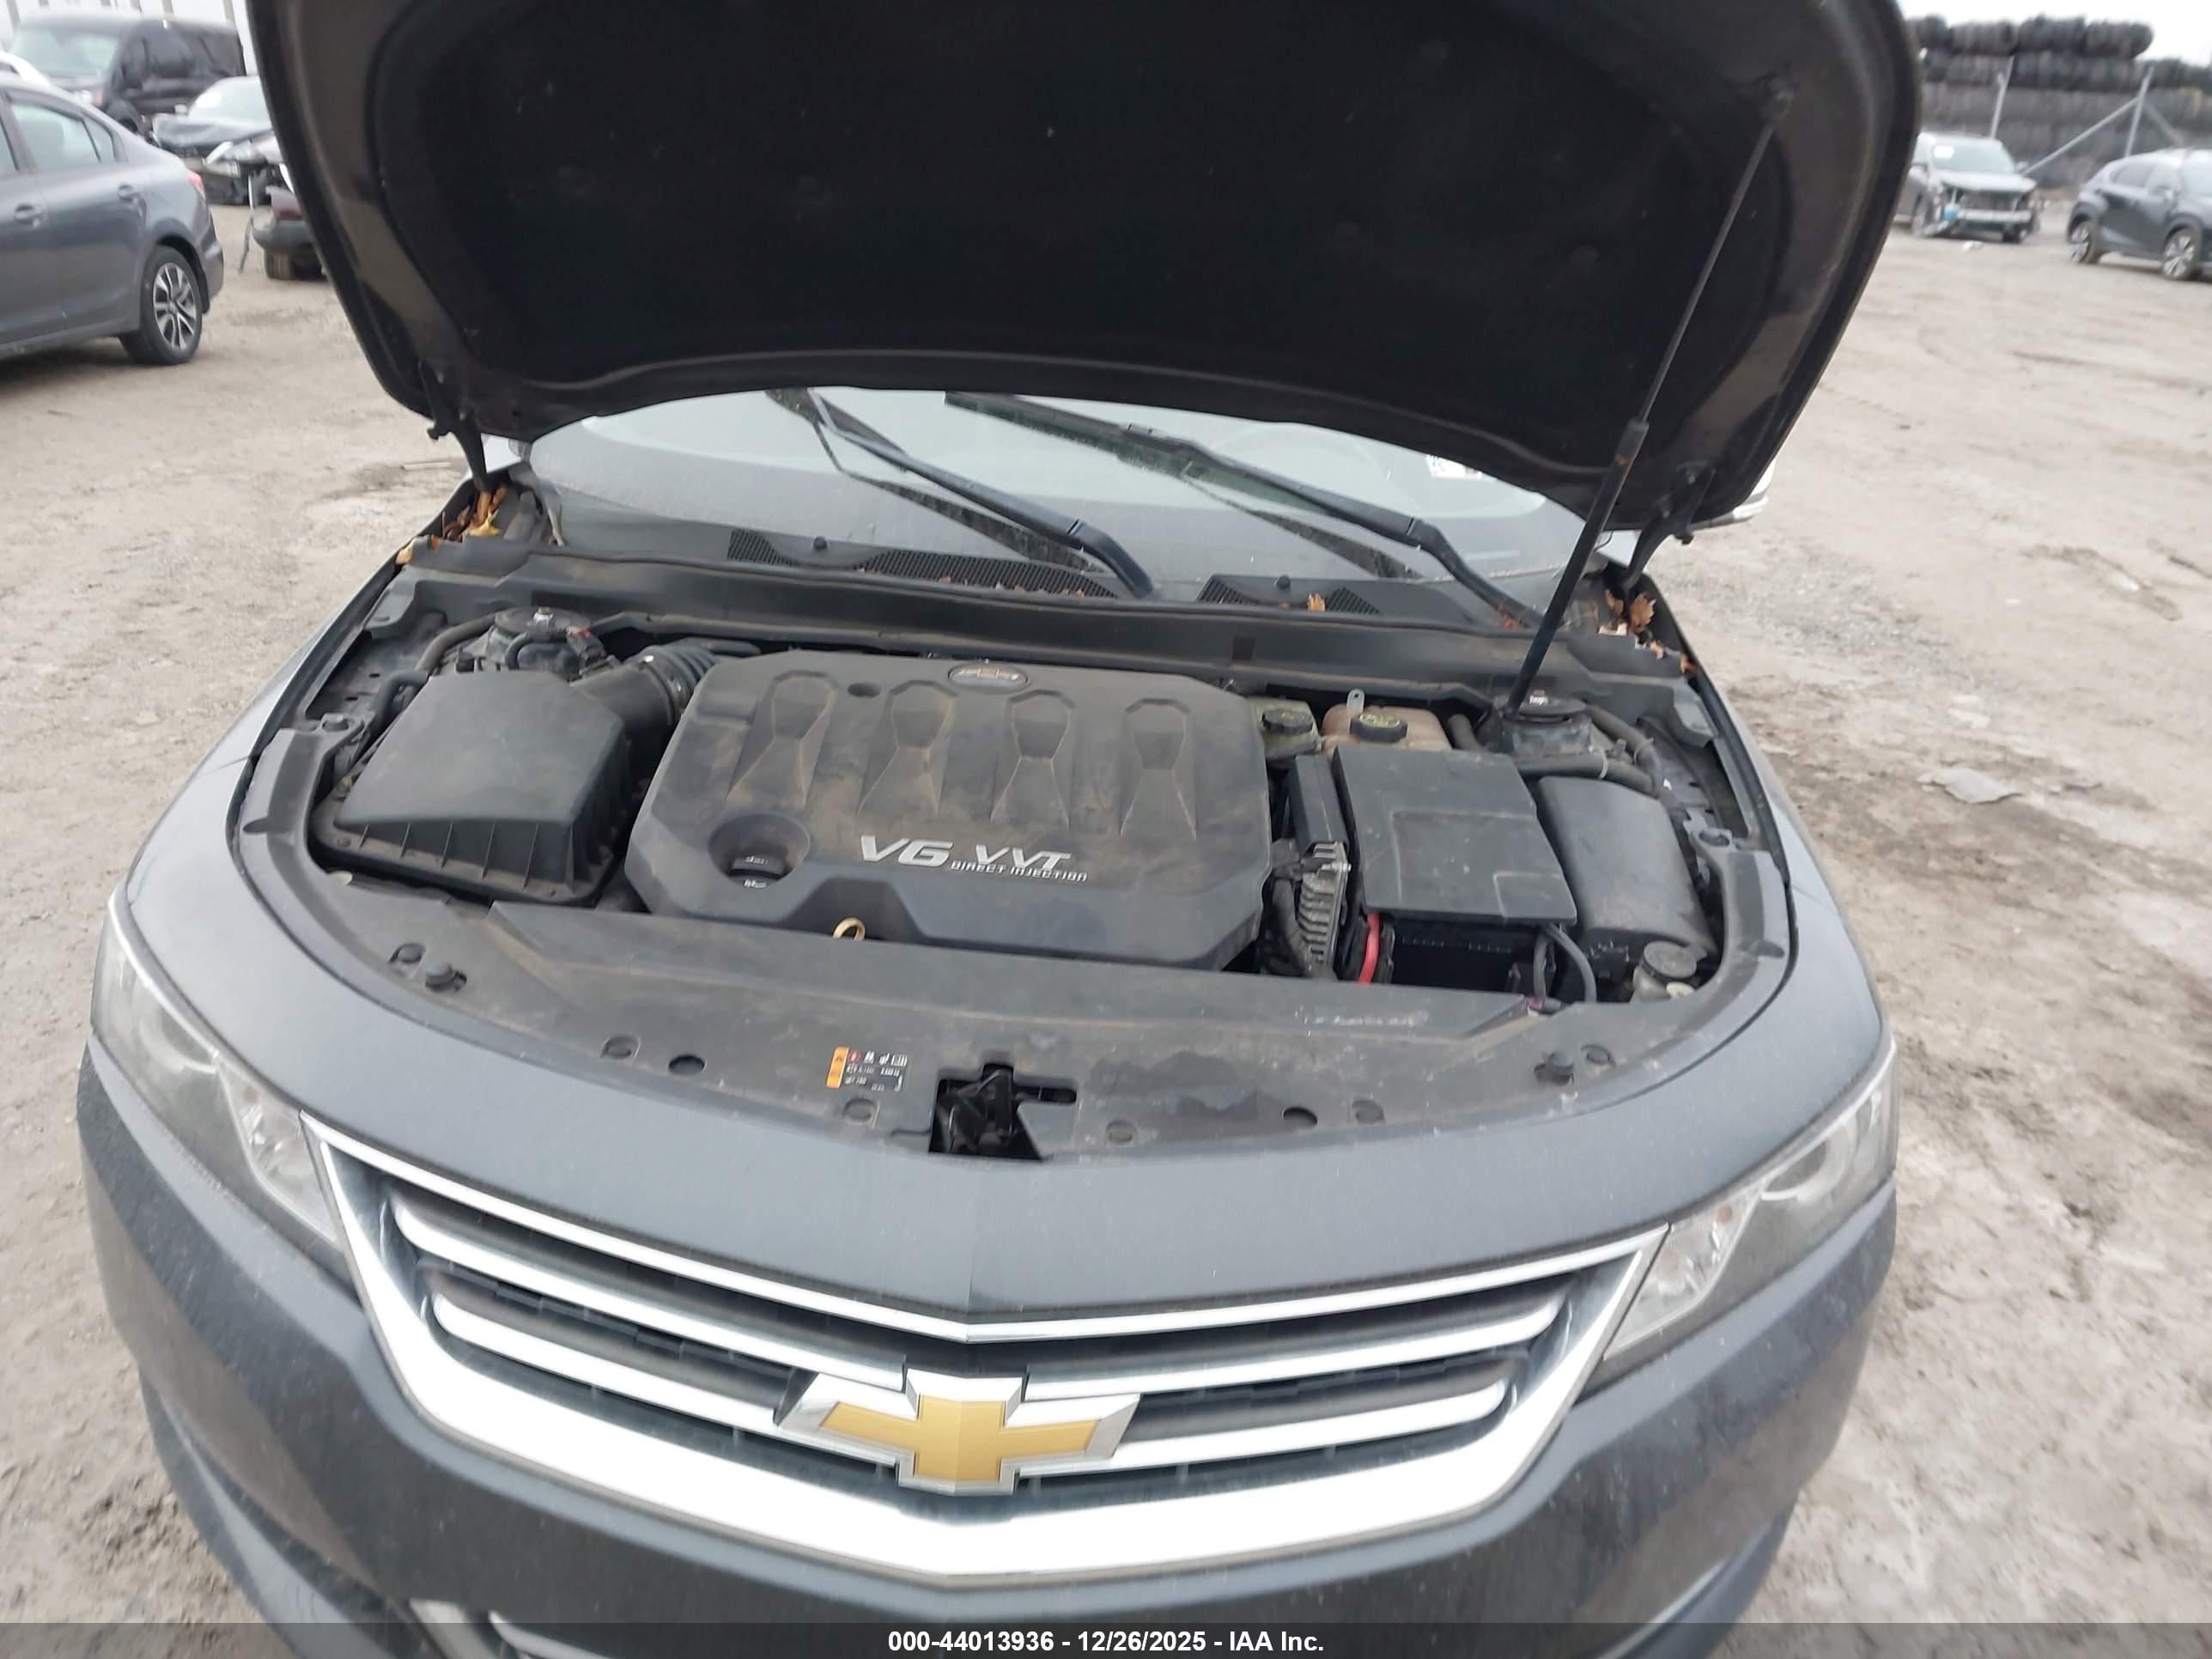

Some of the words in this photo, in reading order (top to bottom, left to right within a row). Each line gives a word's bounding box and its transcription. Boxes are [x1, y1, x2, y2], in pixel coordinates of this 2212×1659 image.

[860, 835, 954, 867] V6
[975, 844, 1073, 871] VVT
[950, 860, 1007, 875] DIRECT
[1010, 866, 1088, 883] INJECTION
